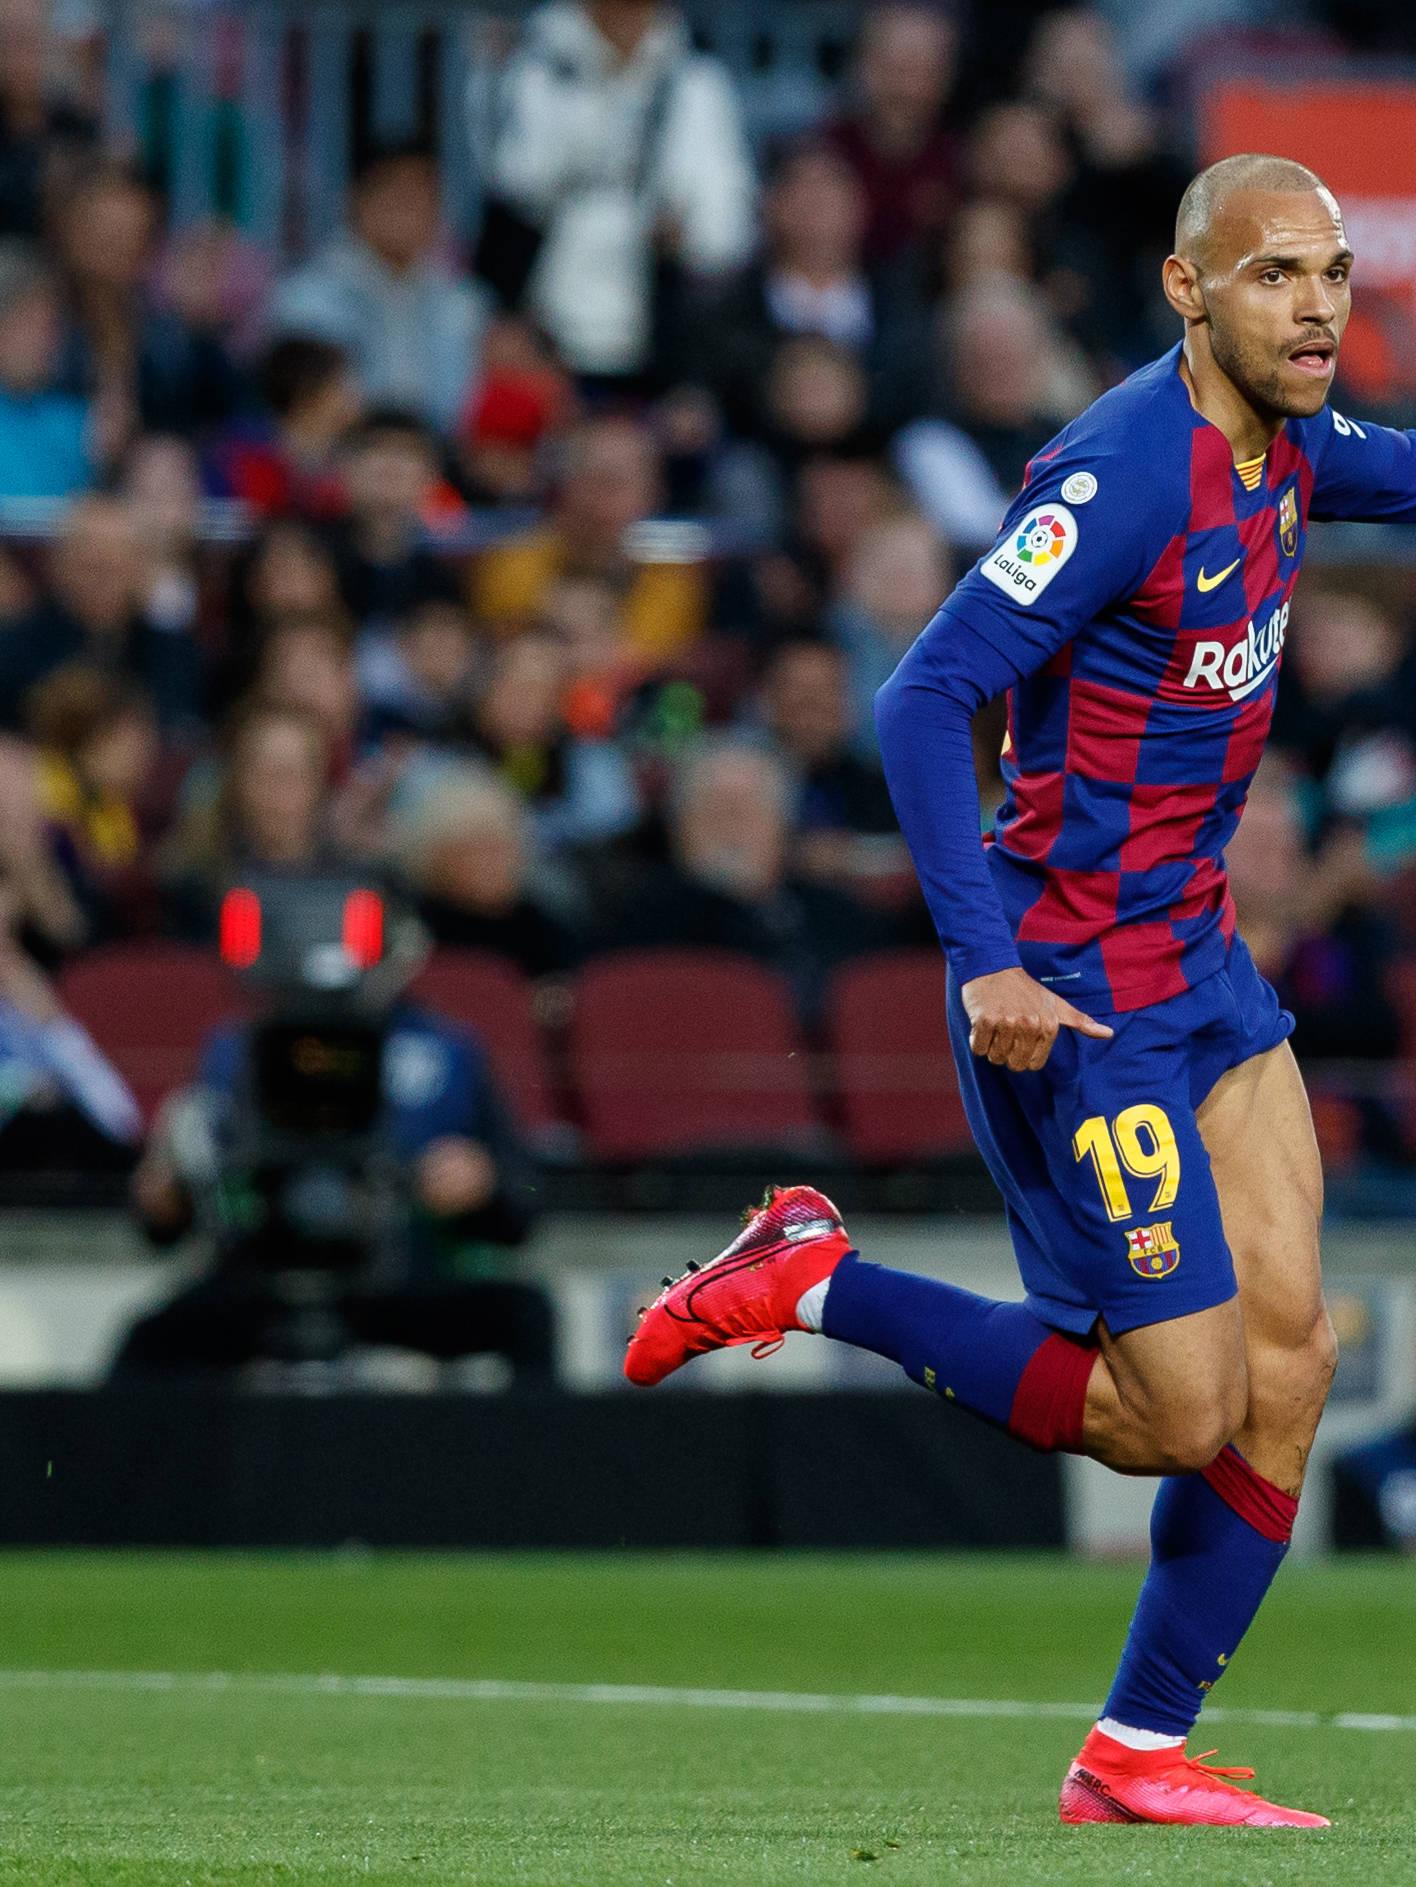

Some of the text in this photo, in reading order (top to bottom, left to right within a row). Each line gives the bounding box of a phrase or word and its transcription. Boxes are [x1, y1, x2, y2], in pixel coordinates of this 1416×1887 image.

[993, 553, 1037, 592] LaLiga
[1183, 597, 1292, 690] Rakute
[1072, 1103, 1181, 1222] 19
